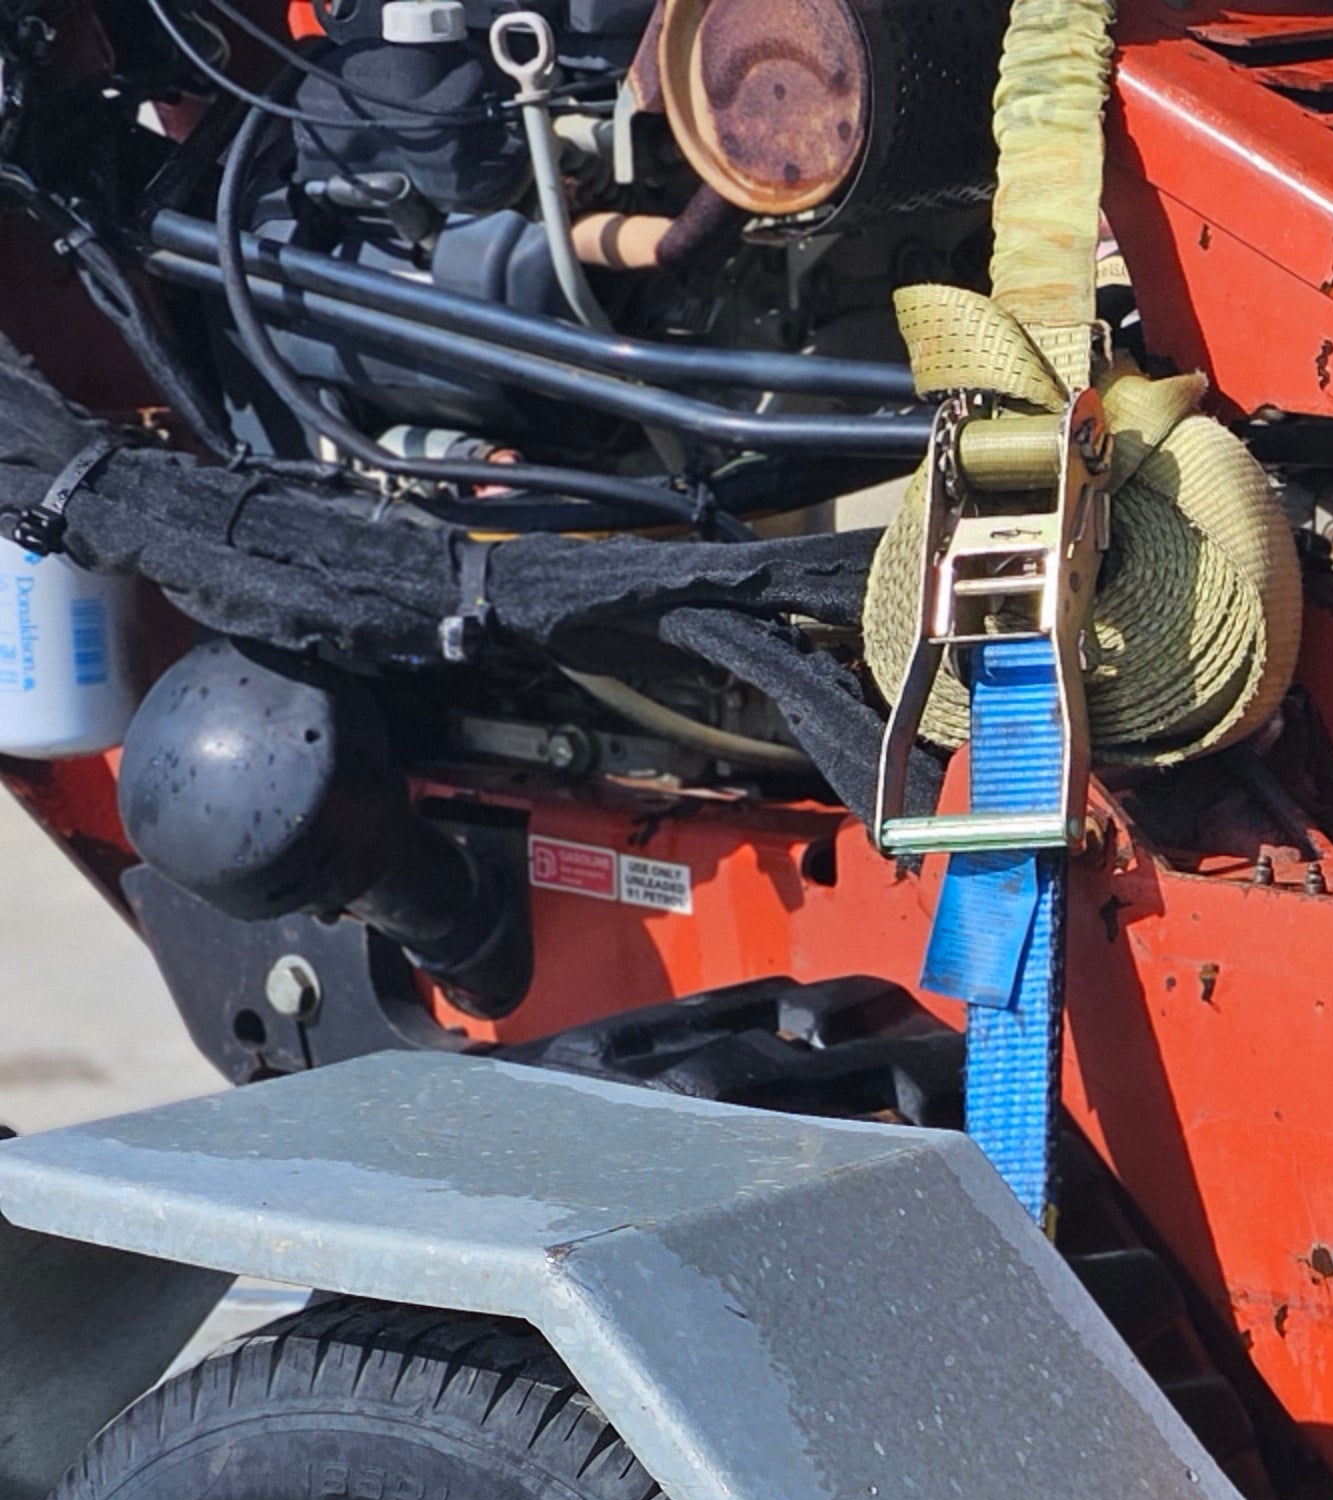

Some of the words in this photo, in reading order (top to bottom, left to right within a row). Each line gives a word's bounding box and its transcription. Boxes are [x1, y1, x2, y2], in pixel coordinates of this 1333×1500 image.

[628, 861, 649, 875] USE
[652, 865, 682, 879] ONLY
[625, 875, 686, 894] UNLEADED
[627, 887, 641, 900] 91
[643, 890, 686, 908] PETROL
